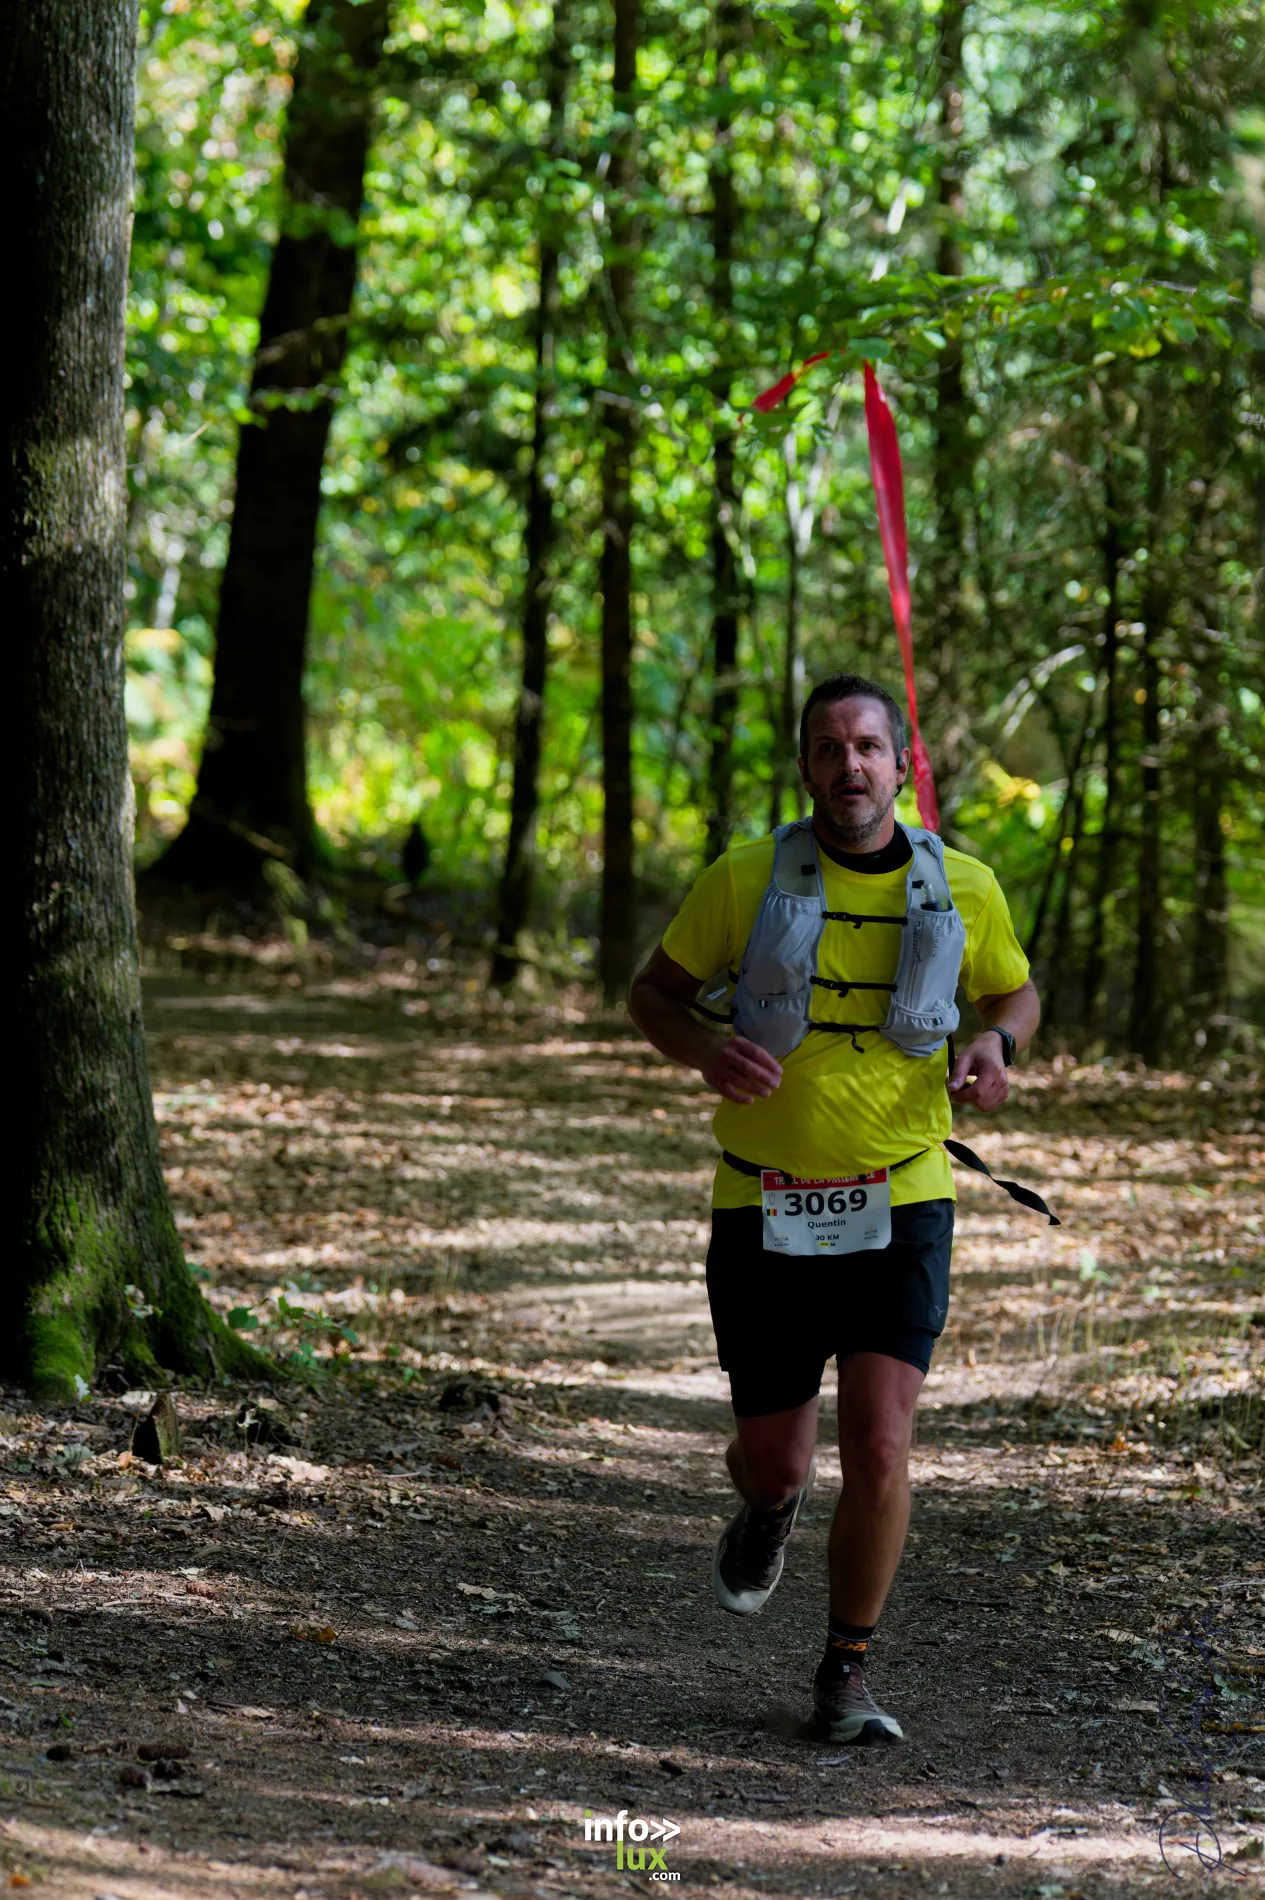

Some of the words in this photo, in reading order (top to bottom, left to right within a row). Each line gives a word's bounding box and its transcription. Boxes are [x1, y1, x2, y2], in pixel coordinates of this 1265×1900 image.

[932, 925, 941, 958] KIPRUN
[784, 1188, 868, 1216] 3069
[807, 1219, 847, 1229] Quentin
